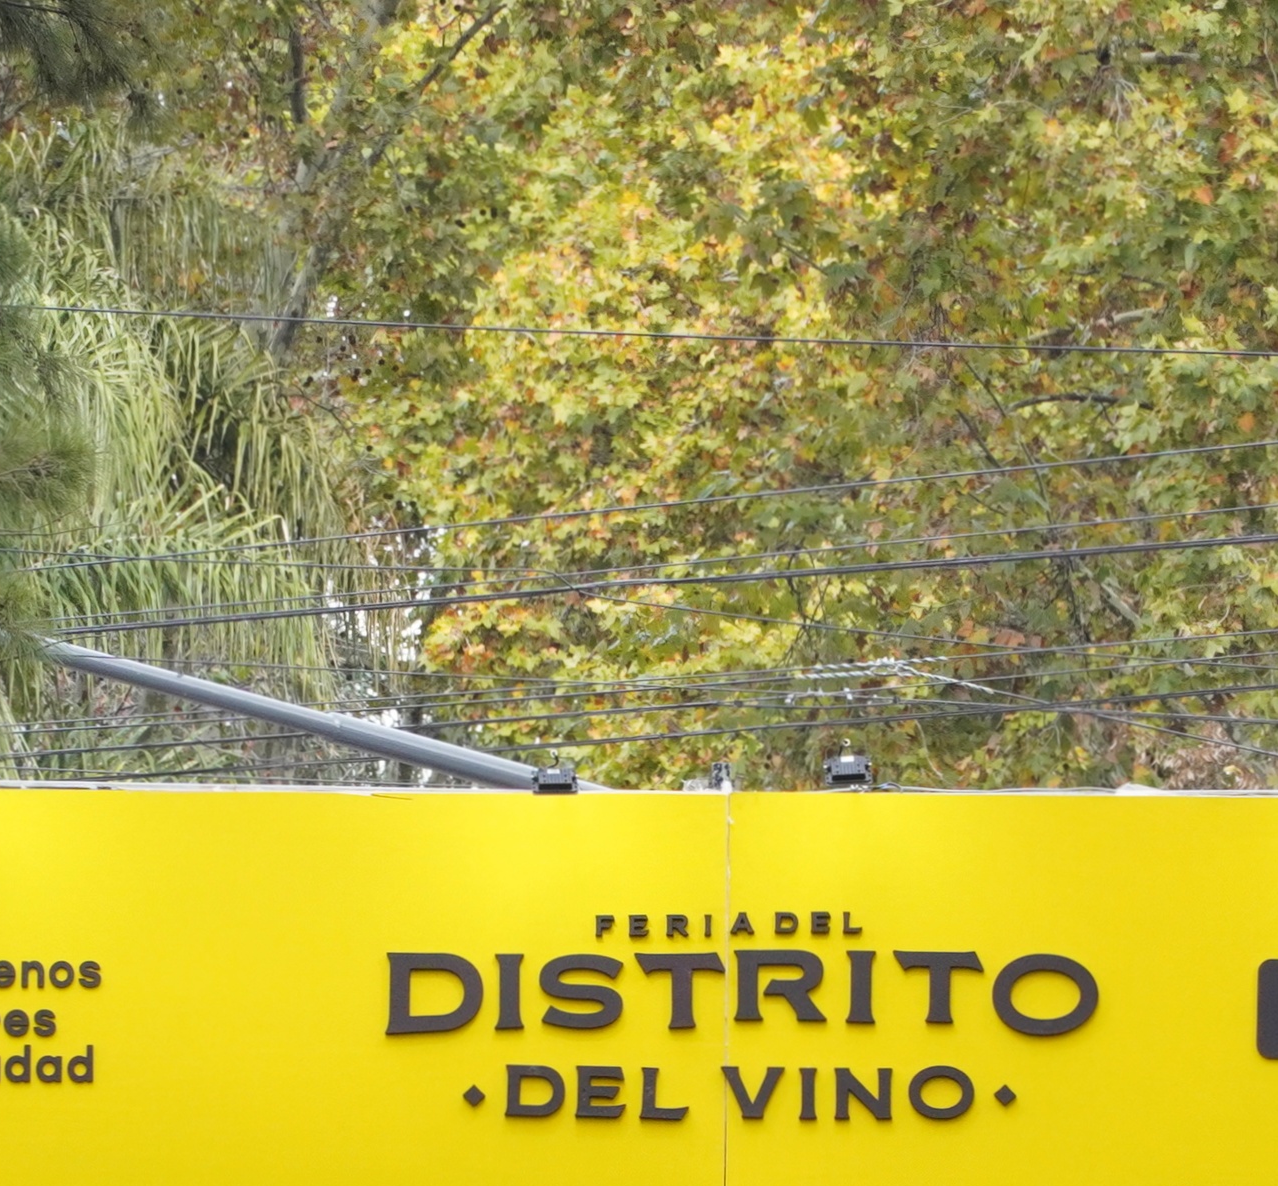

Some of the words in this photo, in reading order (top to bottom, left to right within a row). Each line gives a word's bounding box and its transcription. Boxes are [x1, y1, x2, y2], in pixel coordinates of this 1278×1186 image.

[385, 949, 1100, 1038] DISTRITO
[505, 1064, 690, 1122] DEL
[721, 1065, 975, 1121] VINO
